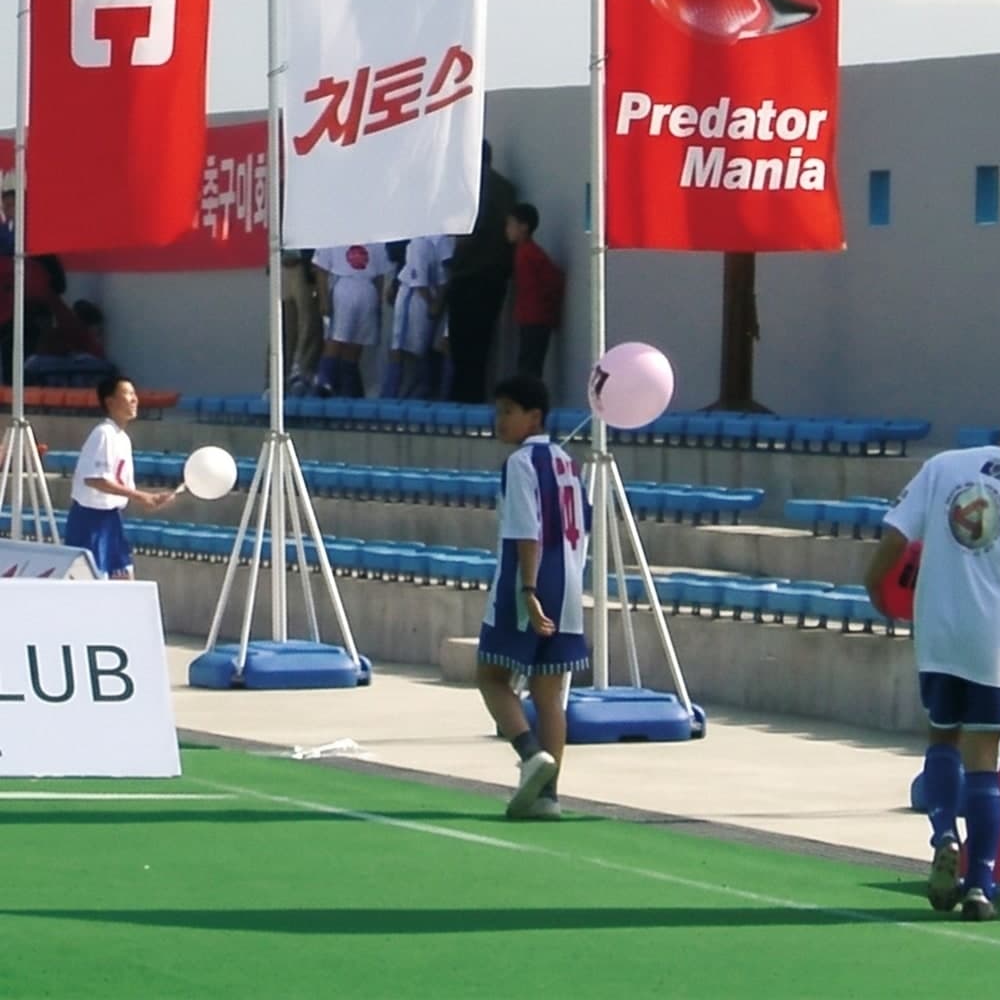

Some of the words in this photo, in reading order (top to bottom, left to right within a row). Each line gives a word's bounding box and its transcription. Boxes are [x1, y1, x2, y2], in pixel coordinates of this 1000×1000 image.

[293, 46, 472, 155] 치토스
[616, 92, 828, 141] Predator
[679, 145, 828, 191] Mania
